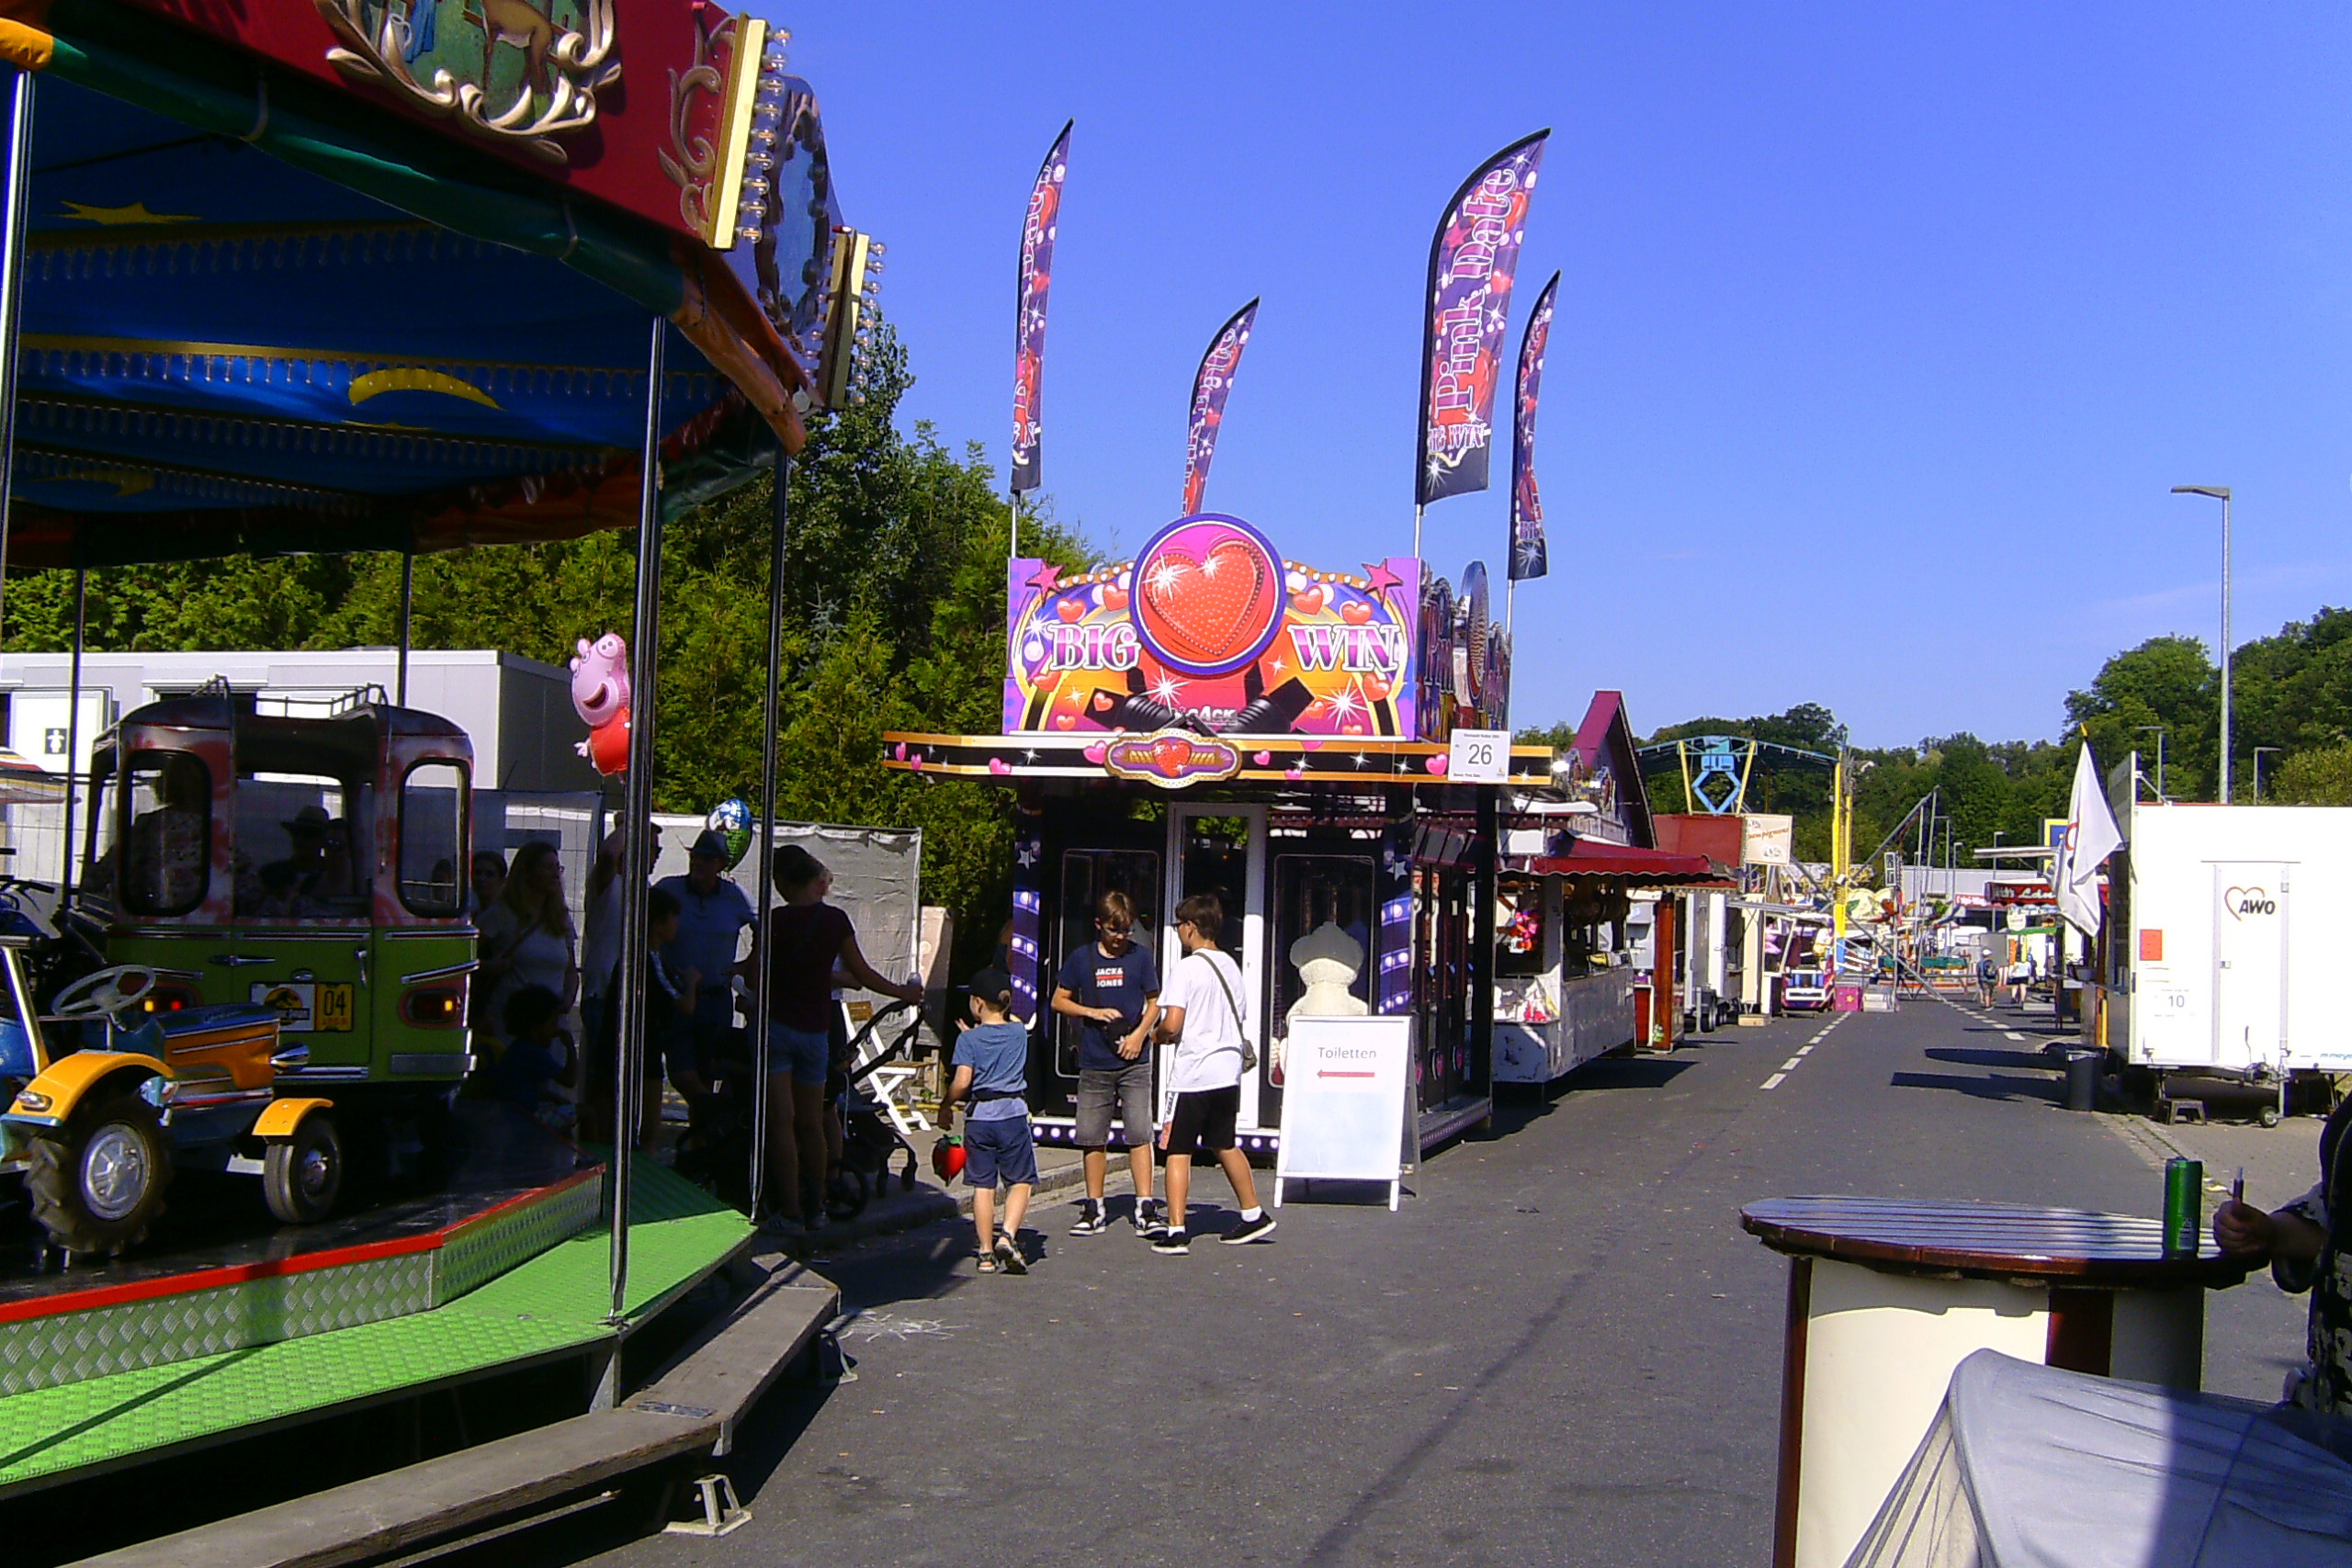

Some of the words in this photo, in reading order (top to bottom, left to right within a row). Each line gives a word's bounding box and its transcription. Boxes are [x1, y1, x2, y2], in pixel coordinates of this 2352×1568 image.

[1448, 168, 1516, 284] Date
[1433, 288, 1485, 419] Pink
[1447, 423, 1487, 450] WIN
[1049, 624, 1141, 672] BIG
[1288, 624, 1400, 672] WIN
[1468, 743, 1493, 765] 26
[2238, 899, 2277, 915] AWO
[324, 990, 346, 1017] 04
[2167, 994, 2185, 1009] 10
[1317, 1046, 1377, 1059] Toiletten
